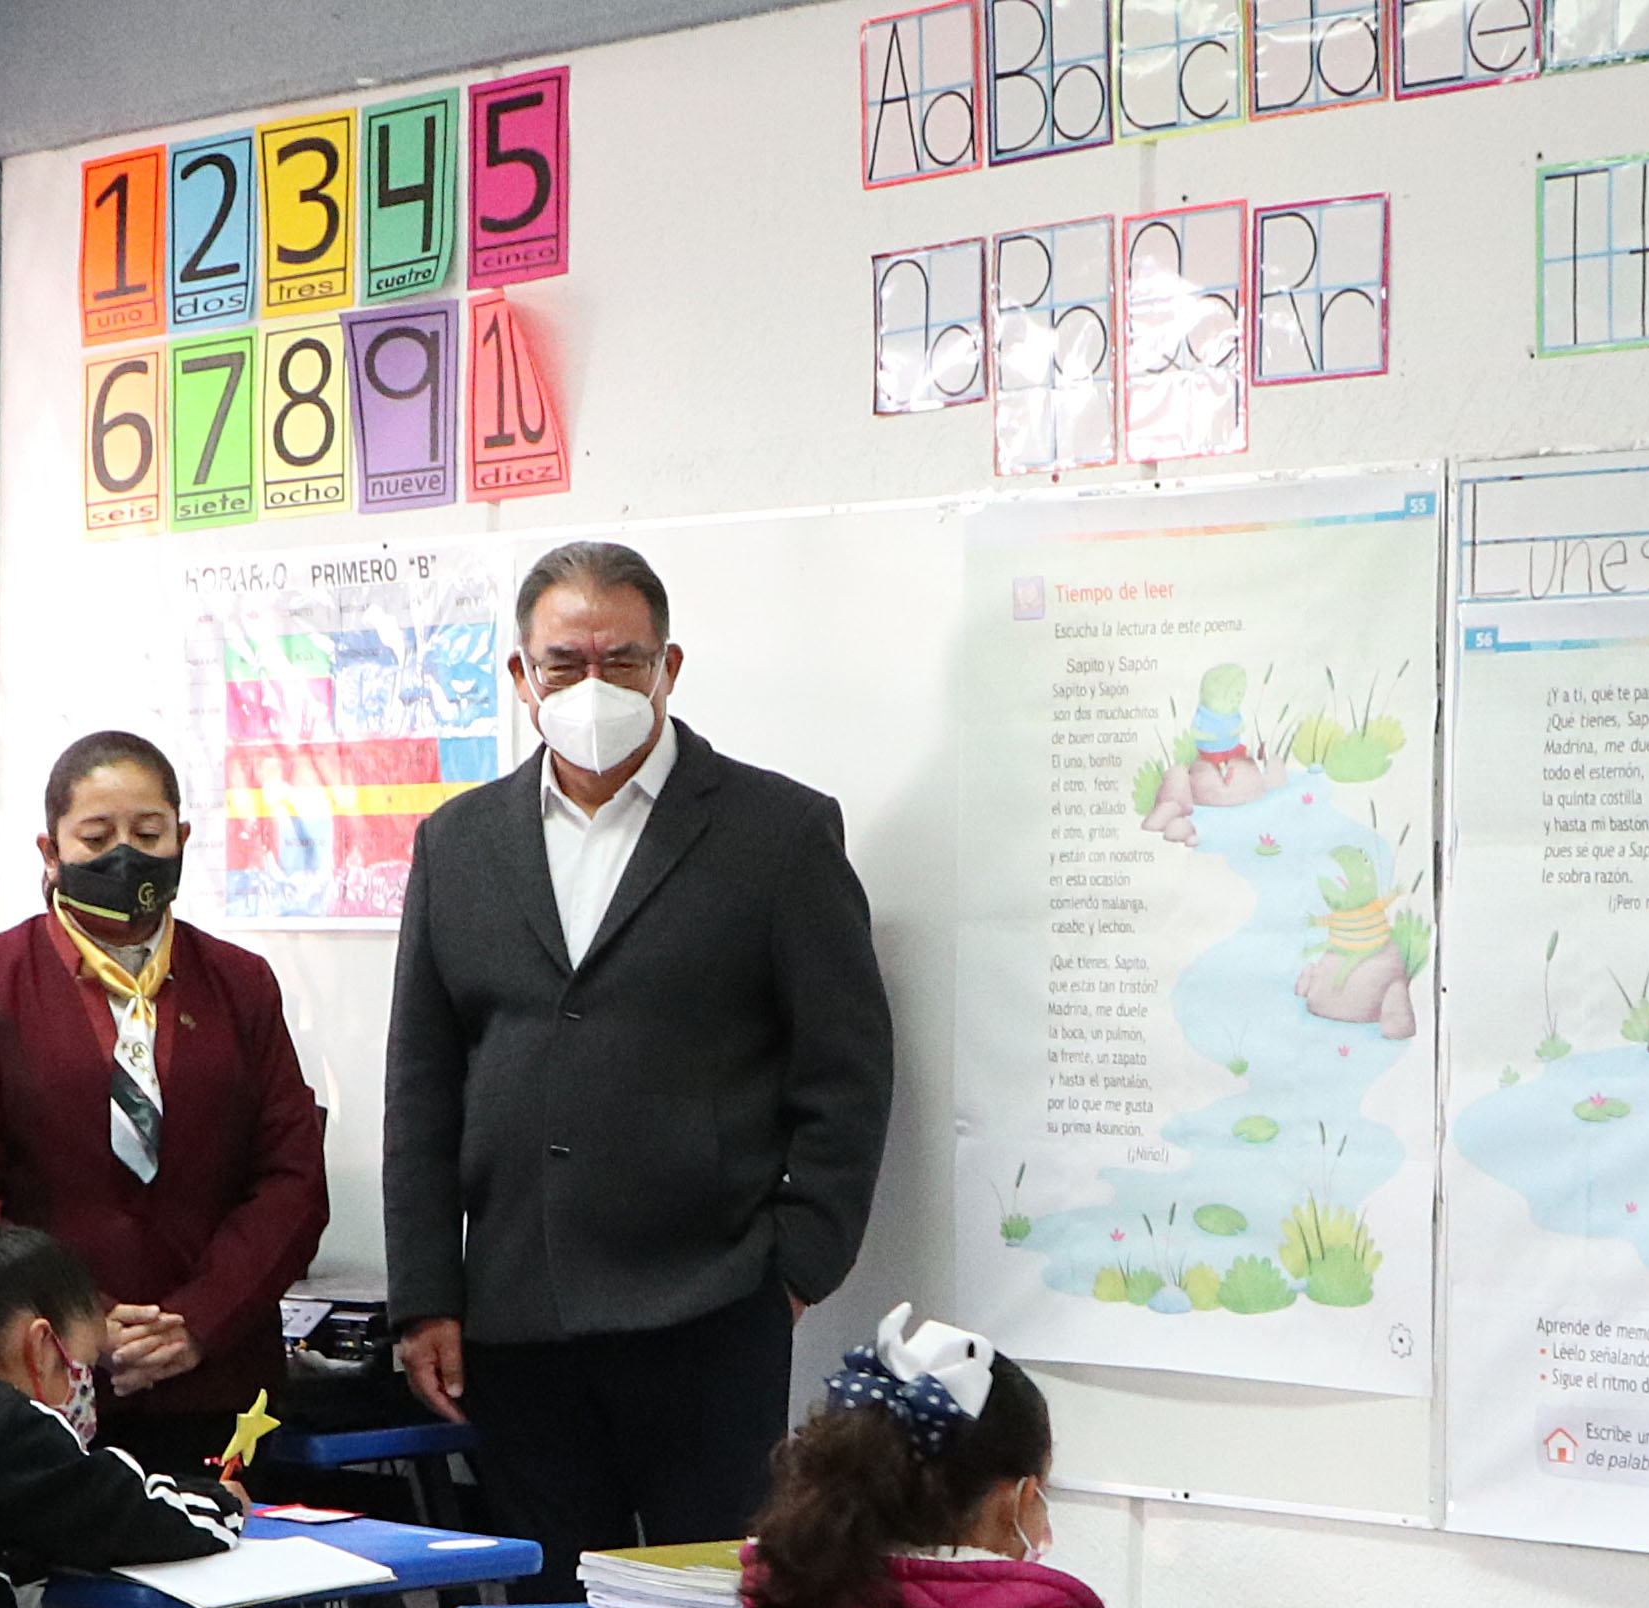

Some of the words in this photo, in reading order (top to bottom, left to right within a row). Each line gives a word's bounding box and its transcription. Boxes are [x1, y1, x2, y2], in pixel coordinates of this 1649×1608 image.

[480, 92, 550, 233] 5
[377, 115, 436, 254] 4
[276, 137, 341, 264] 3
[179, 152, 242, 283] 2
[94, 173, 147, 299] 1
[481, 246, 557, 269] cinco
[277, 279, 335, 301] tres
[375, 268, 433, 291] cuatro
[176, 291, 244, 319] dos
[96, 307, 143, 328] uno
[273, 338, 335, 468] 8
[364, 326, 439, 463] 9
[92, 360, 152, 493] 6
[182, 351, 246, 486] 7
[371, 473, 442, 496] nueve
[480, 463, 553, 485] diez
[179, 493, 246, 518] siete
[269, 483, 341, 506] ocho
[1410, 497, 1427, 514] 55
[91, 504, 154, 523] seis
[311, 558, 398, 587] PRIMERO
[1475, 631, 1495, 648] 56
[1562, 690, 1570, 704] a
[1617, 685, 1630, 702] te
[1604, 740, 1625, 754] me
[1542, 764, 1571, 782] todo
[1573, 763, 1586, 782] el
[1542, 790, 1553, 807] la
[1557, 789, 1596, 809] quinta
[1600, 788, 1642, 807] costilla
[1543, 820, 1550, 837] y
[1554, 816, 1587, 834] hasta
[1591, 815, 1606, 832] mi
[1544, 845, 1573, 862] pues
[1591, 844, 1615, 862] que
[1618, 844, 1626, 859] a
[1541, 867, 1554, 885] le
[1557, 867, 1591, 885] sobra
[1536, 1315, 1590, 1338] Aprende
[1594, 1319, 1612, 1339] de
[1552, 1368, 1583, 1391] Sigue
[1586, 1372, 1598, 1390] el
[1602, 1375, 1637, 1394] ritmo
[1585, 1421, 1632, 1444] Escribe
[1586, 1449, 1605, 1468] de
